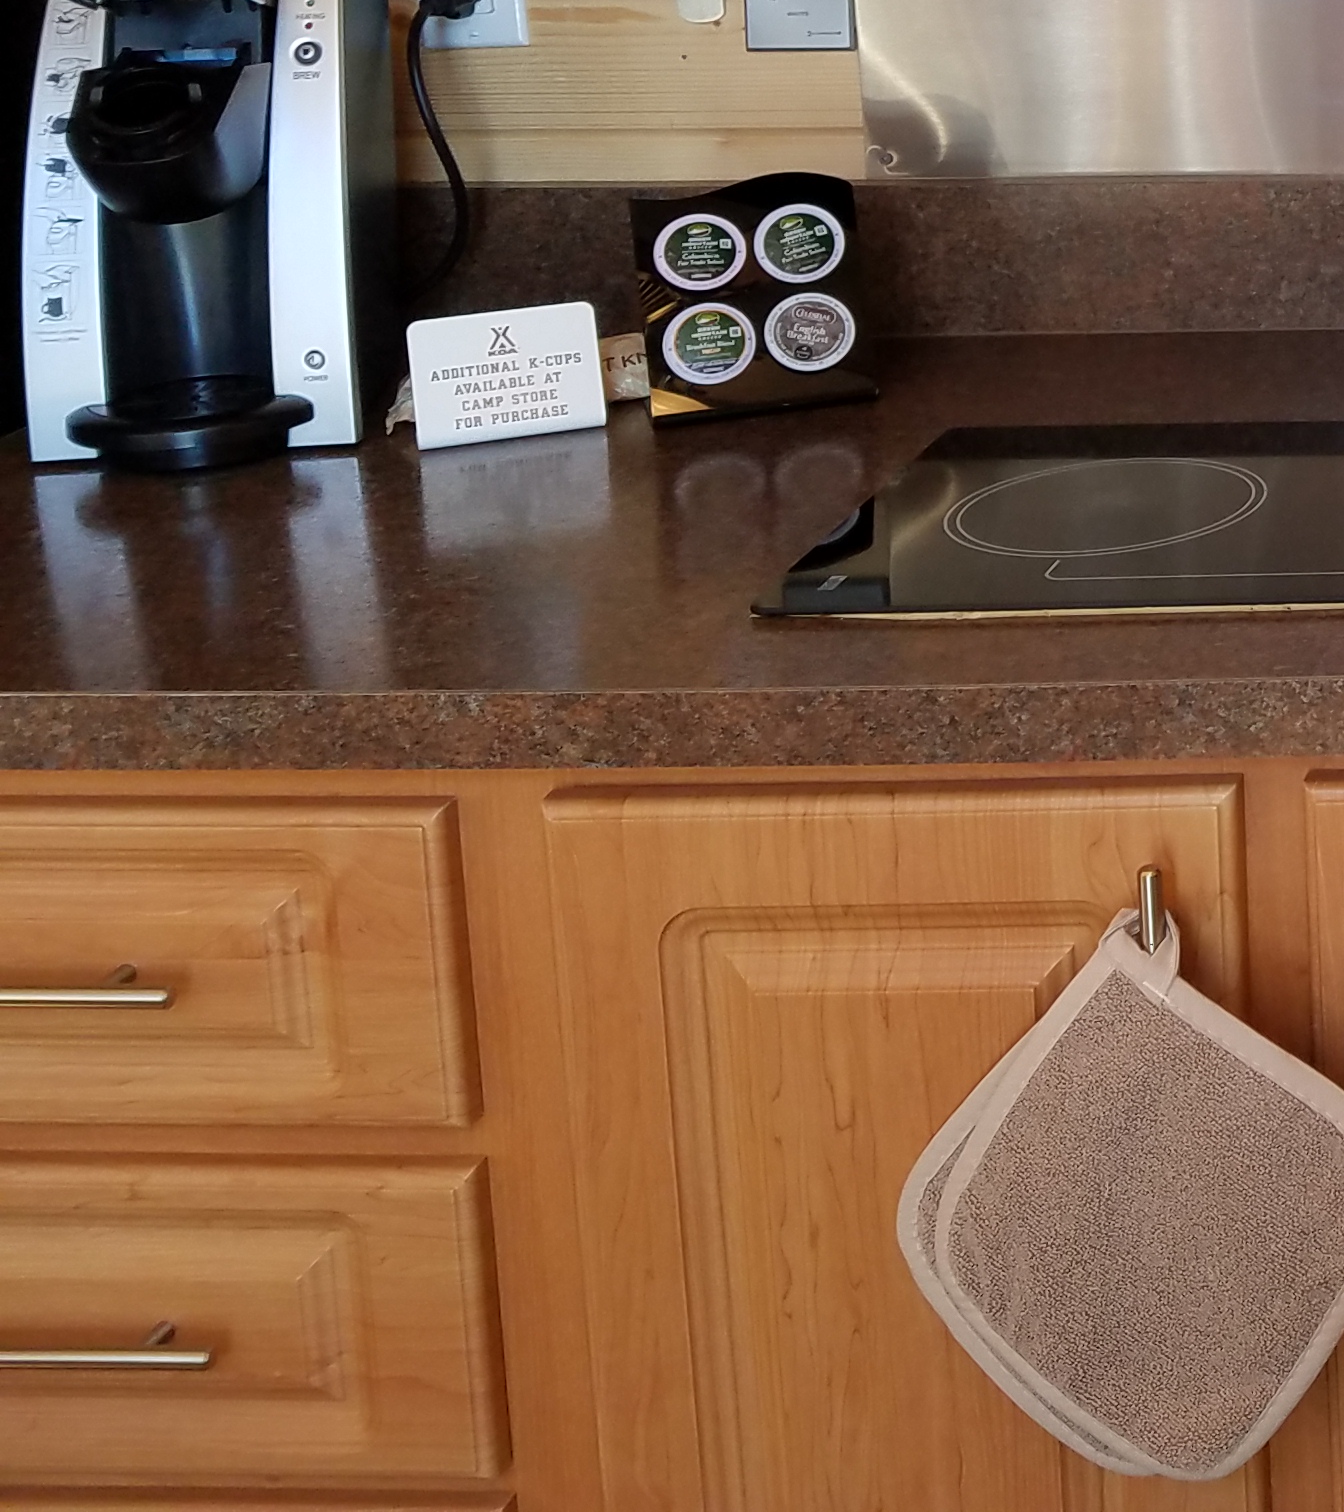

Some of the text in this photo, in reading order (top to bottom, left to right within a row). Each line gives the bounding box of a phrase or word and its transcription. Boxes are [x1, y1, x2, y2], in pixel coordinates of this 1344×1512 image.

[292, 71, 321, 80] BREW
[786, 330, 829, 345] Breakfast
[793, 323, 827, 336] English
[431, 352, 582, 382] ADDITIONAL K-CUPS
[454, 372, 562, 396] AVAILABLE AT
[462, 389, 558, 412] CAMP STORE
[455, 404, 569, 430] FOR PURCHASE
